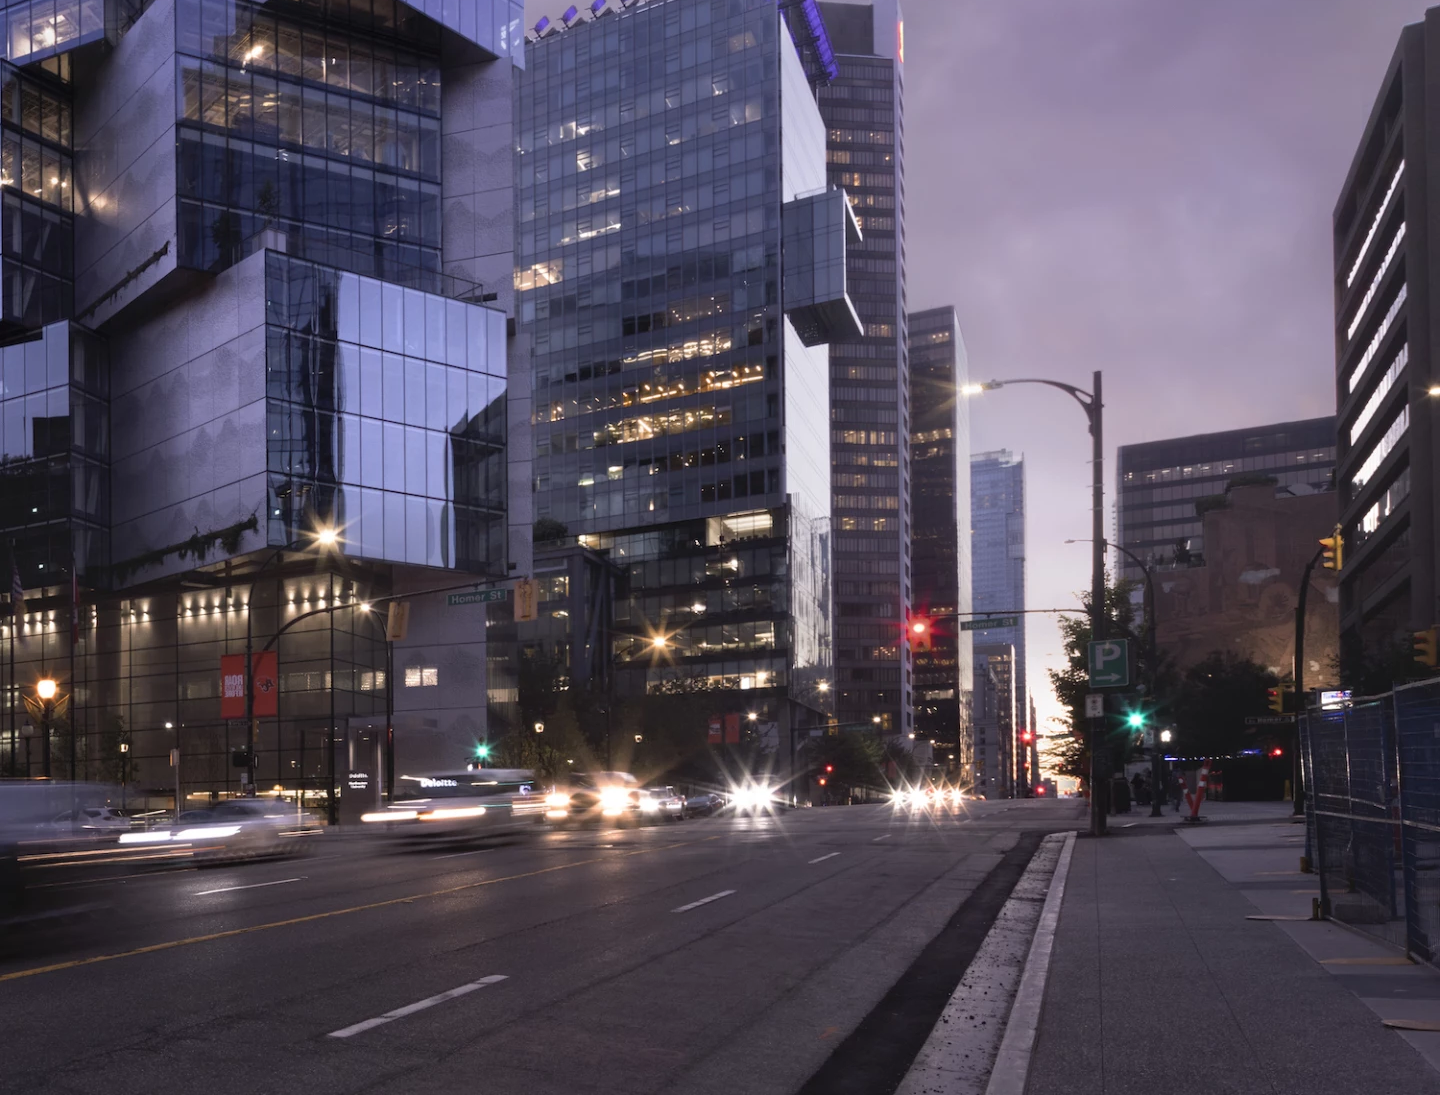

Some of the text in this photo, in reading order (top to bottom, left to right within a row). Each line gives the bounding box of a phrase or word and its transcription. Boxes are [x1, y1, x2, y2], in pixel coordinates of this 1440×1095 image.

[451, 590, 502, 604] Homer St
[964, 618, 1014, 630] Homer St
[1095, 643, 1121, 670] P
